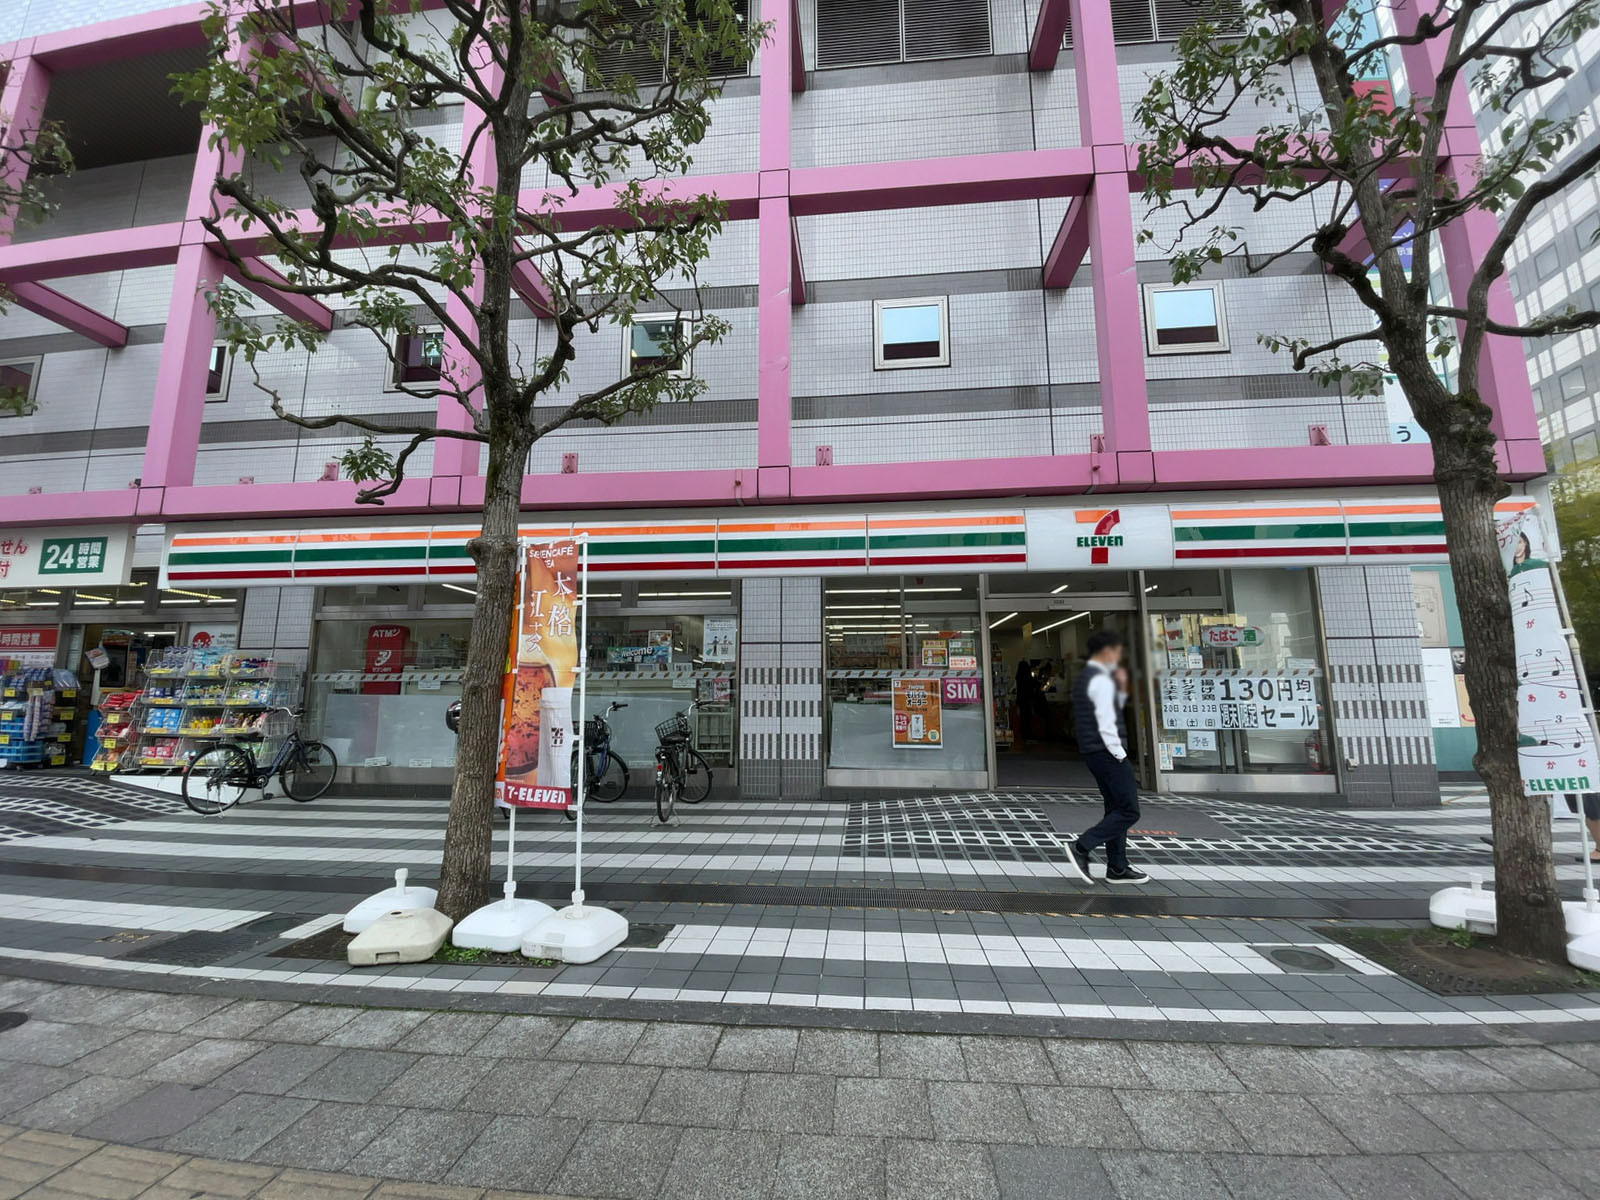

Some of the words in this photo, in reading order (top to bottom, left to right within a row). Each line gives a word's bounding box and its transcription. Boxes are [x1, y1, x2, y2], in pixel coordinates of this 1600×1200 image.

[1396, 426, 1411, 442] う
[1, 540, 27, 554] せん
[1076, 535, 1123, 547] ELEVEN
[79, 542, 102, 554] 時間
[44, 544, 74, 569] 24
[77, 555, 100, 568] 営業
[548, 571, 573, 636] 本格
[0, 632, 40, 646] 時間営業
[372, 629, 393, 638] ATM
[1209, 629, 1238, 642] たばこ
[1243, 629, 1257, 641] 酒
[621, 646, 653, 658] Welcome
[1535, 648, 1542, 657] 3
[946, 683, 978, 699] SIM
[1182, 705, 1198, 713] 21日
[1202, 705, 1217, 713] 22日
[1555, 714, 1562, 724] 3
[507, 785, 566, 803] 7-ELEVEN
